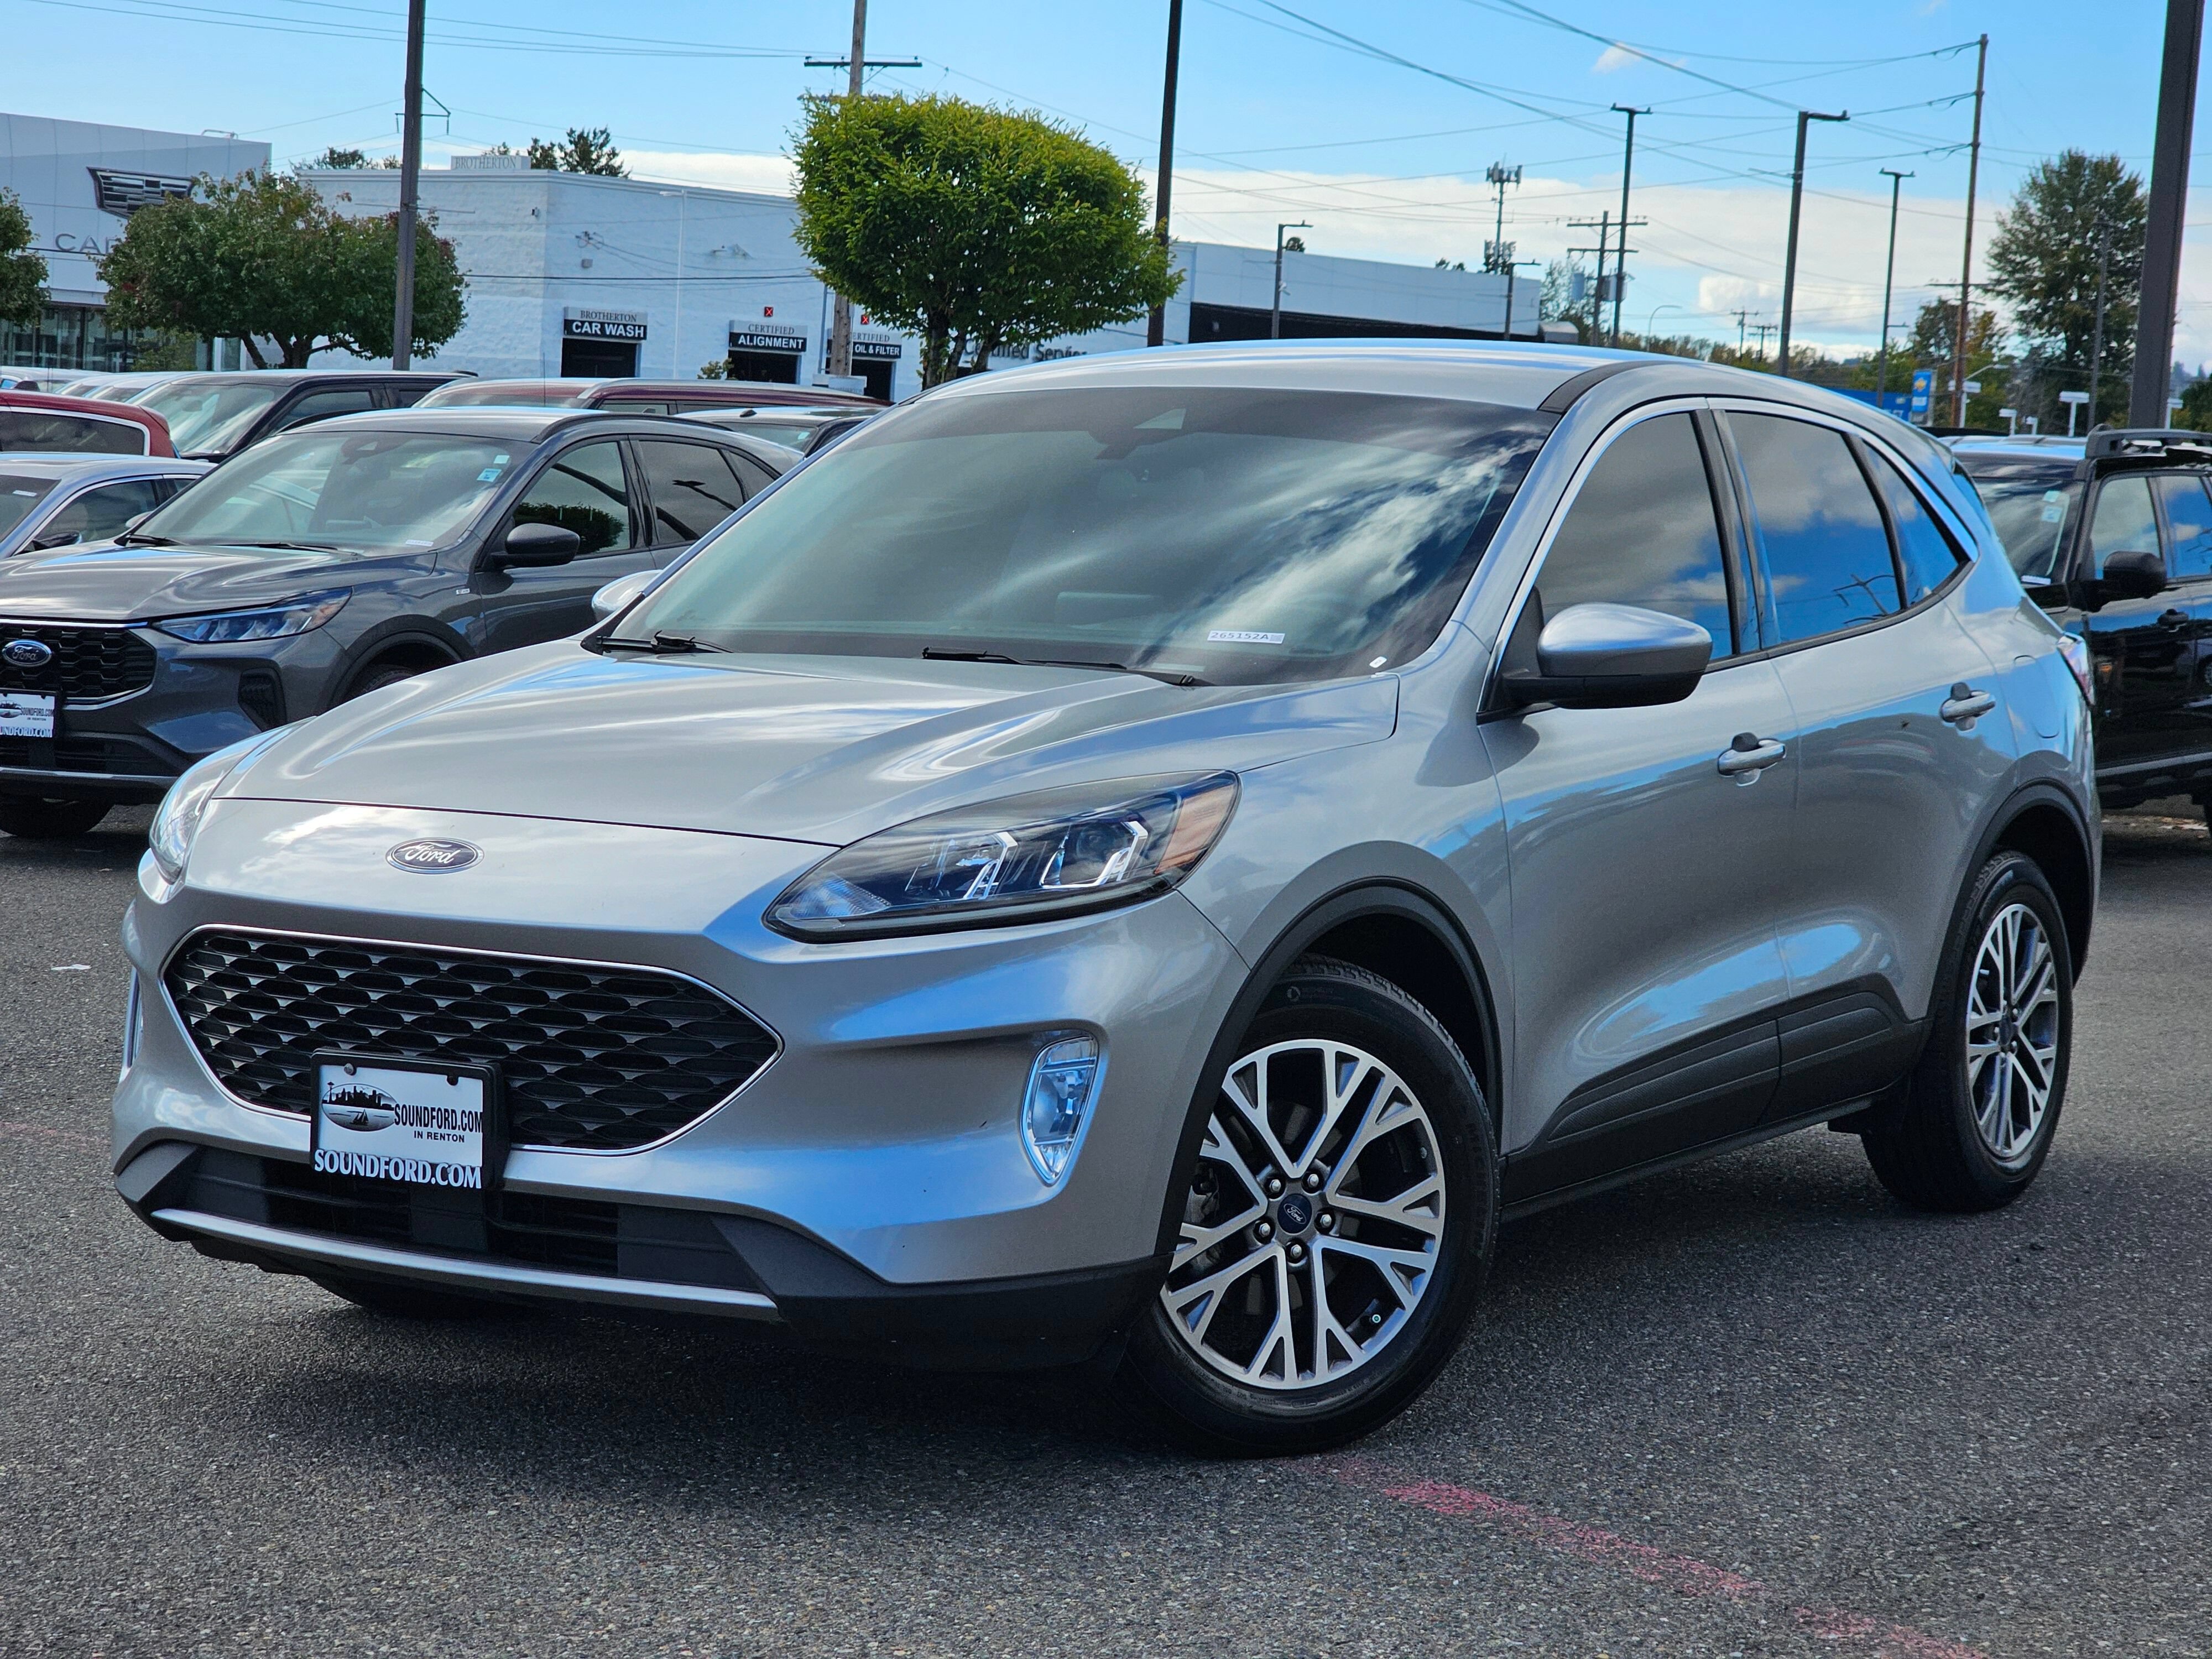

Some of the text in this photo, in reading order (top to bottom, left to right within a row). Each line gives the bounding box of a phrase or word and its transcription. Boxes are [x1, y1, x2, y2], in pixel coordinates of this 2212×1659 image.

[455, 156, 517, 169] BROTHERTON
[581, 310, 637, 322] BROTHERTON
[572, 321, 644, 337] CAR WASH
[748, 323, 795, 335] CERTIFIED
[738, 335, 804, 348] ALIGNMENT
[853, 332, 890, 342] ERTIFIED
[855, 344, 900, 356] OIL & FILTER
[1211, 632, 1269, 640] 265152A
[12, 645, 38, 661] Ford
[405, 842, 461, 864] Ford
[394, 1103, 483, 1133] SOUNDFORD.COM
[414, 1130, 465, 1143] IN RENTON
[315, 1149, 482, 1189] SOUNDFORD.COM
[1287, 1207, 1303, 1222] Ford
